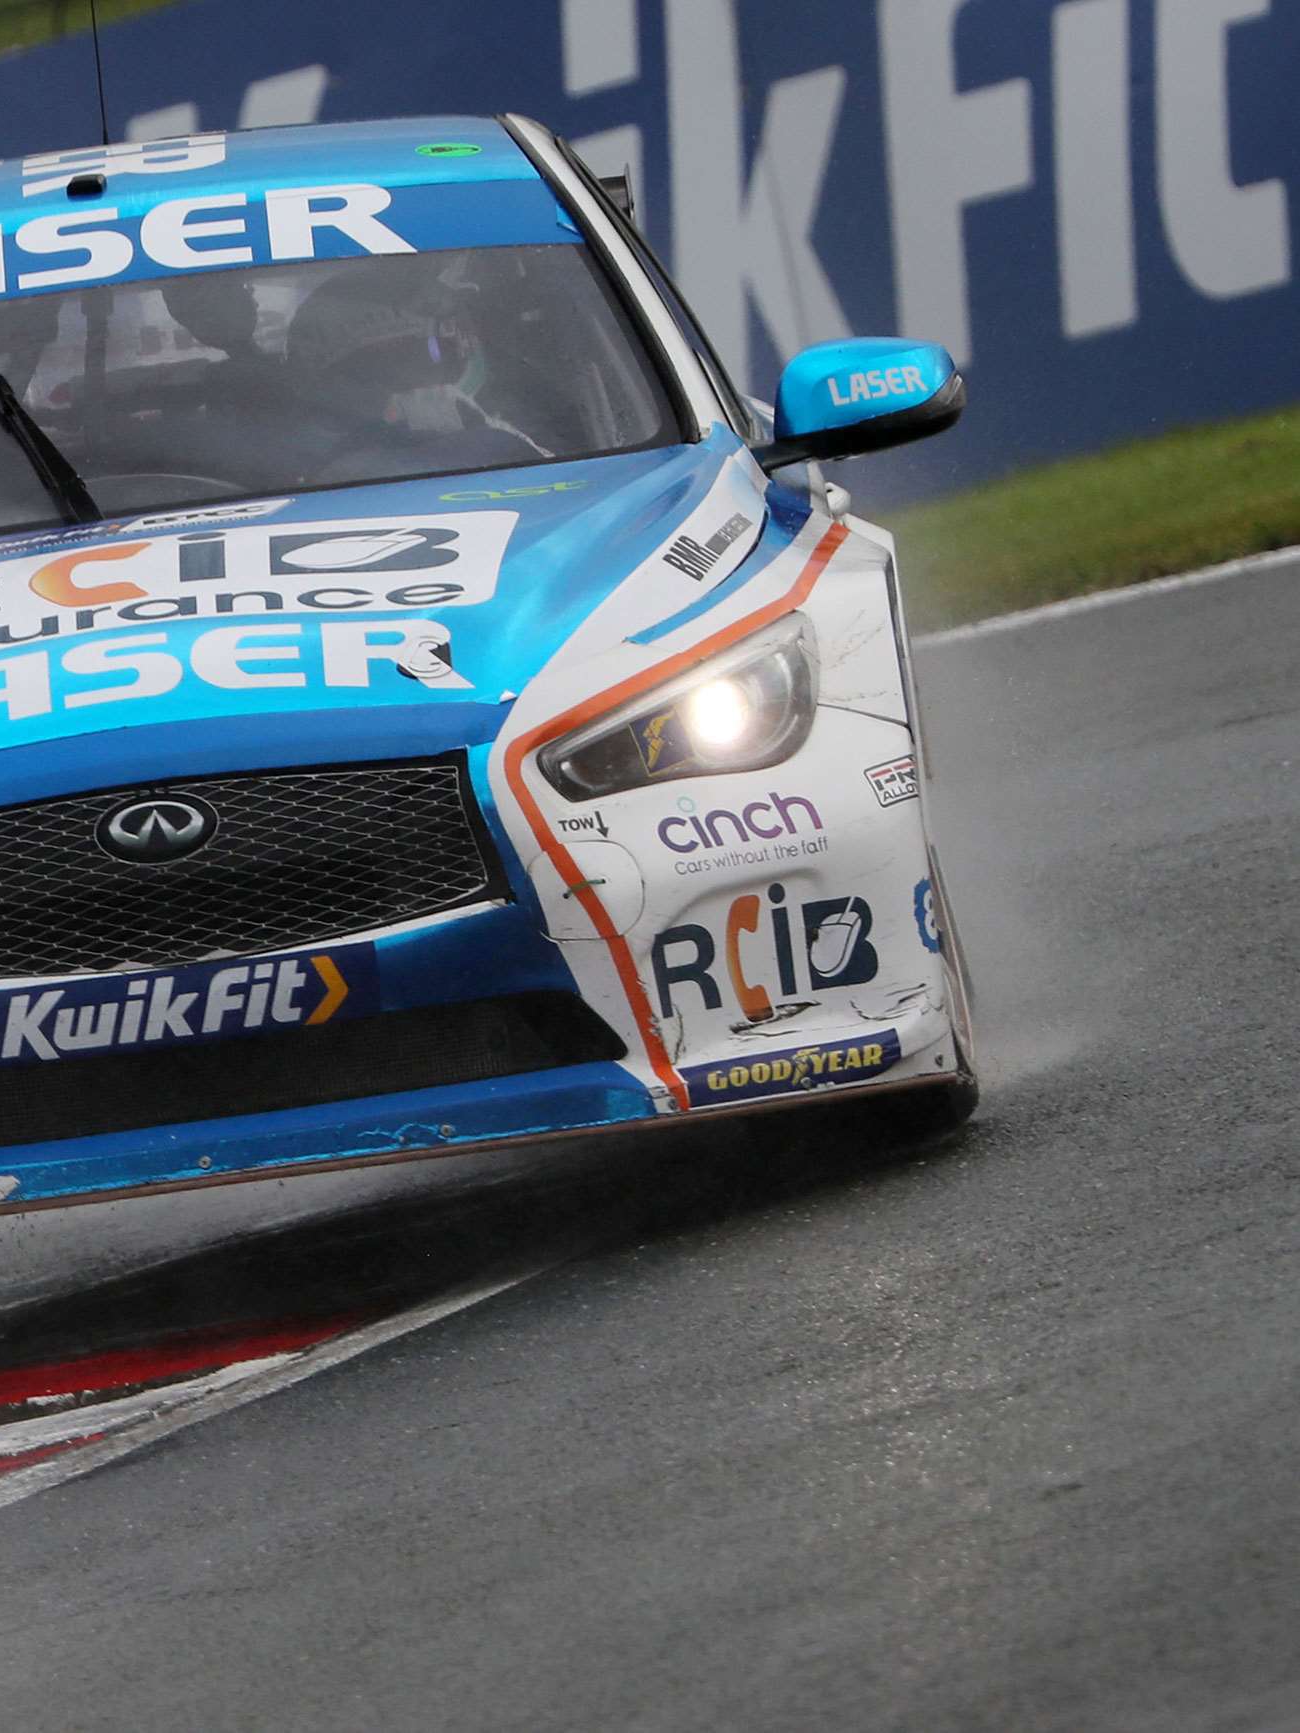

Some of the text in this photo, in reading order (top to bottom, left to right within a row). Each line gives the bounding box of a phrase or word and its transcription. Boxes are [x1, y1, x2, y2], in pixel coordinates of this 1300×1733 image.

[827, 366, 929, 407] LASER
[662, 535, 720, 582] BMR
[558, 816, 595, 832] TOW
[656, 791, 824, 854] cinch
[674, 858, 712, 876] Cars
[715, 846, 772, 870] without
[774, 843, 799, 860] the
[0, 959, 305, 1061] Kwik Fit
